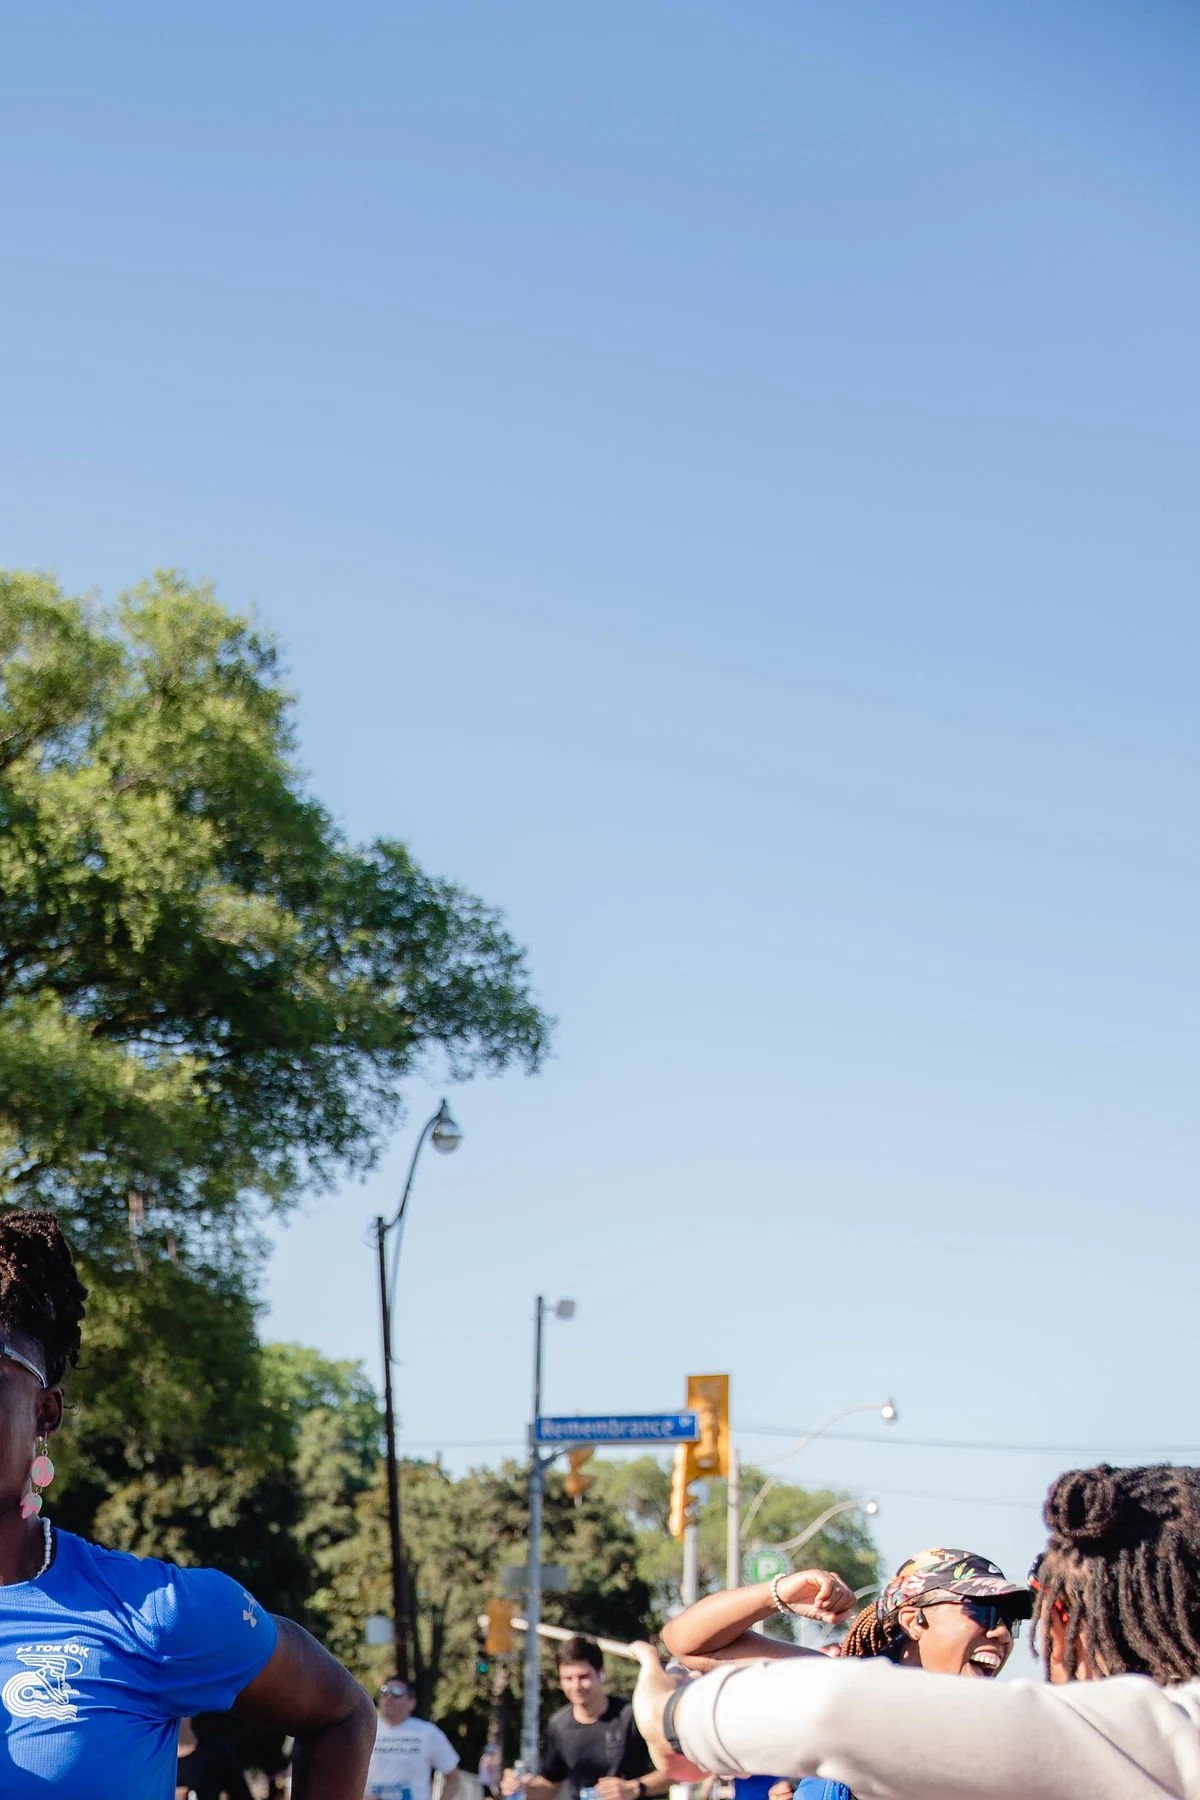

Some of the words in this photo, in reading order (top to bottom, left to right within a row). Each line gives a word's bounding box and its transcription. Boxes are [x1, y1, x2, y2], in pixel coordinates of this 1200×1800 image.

[541, 1418, 674, 1438] Remembrance
[35, 1644, 62, 1653] TOR
[63, 1643, 90, 1658] 10K
